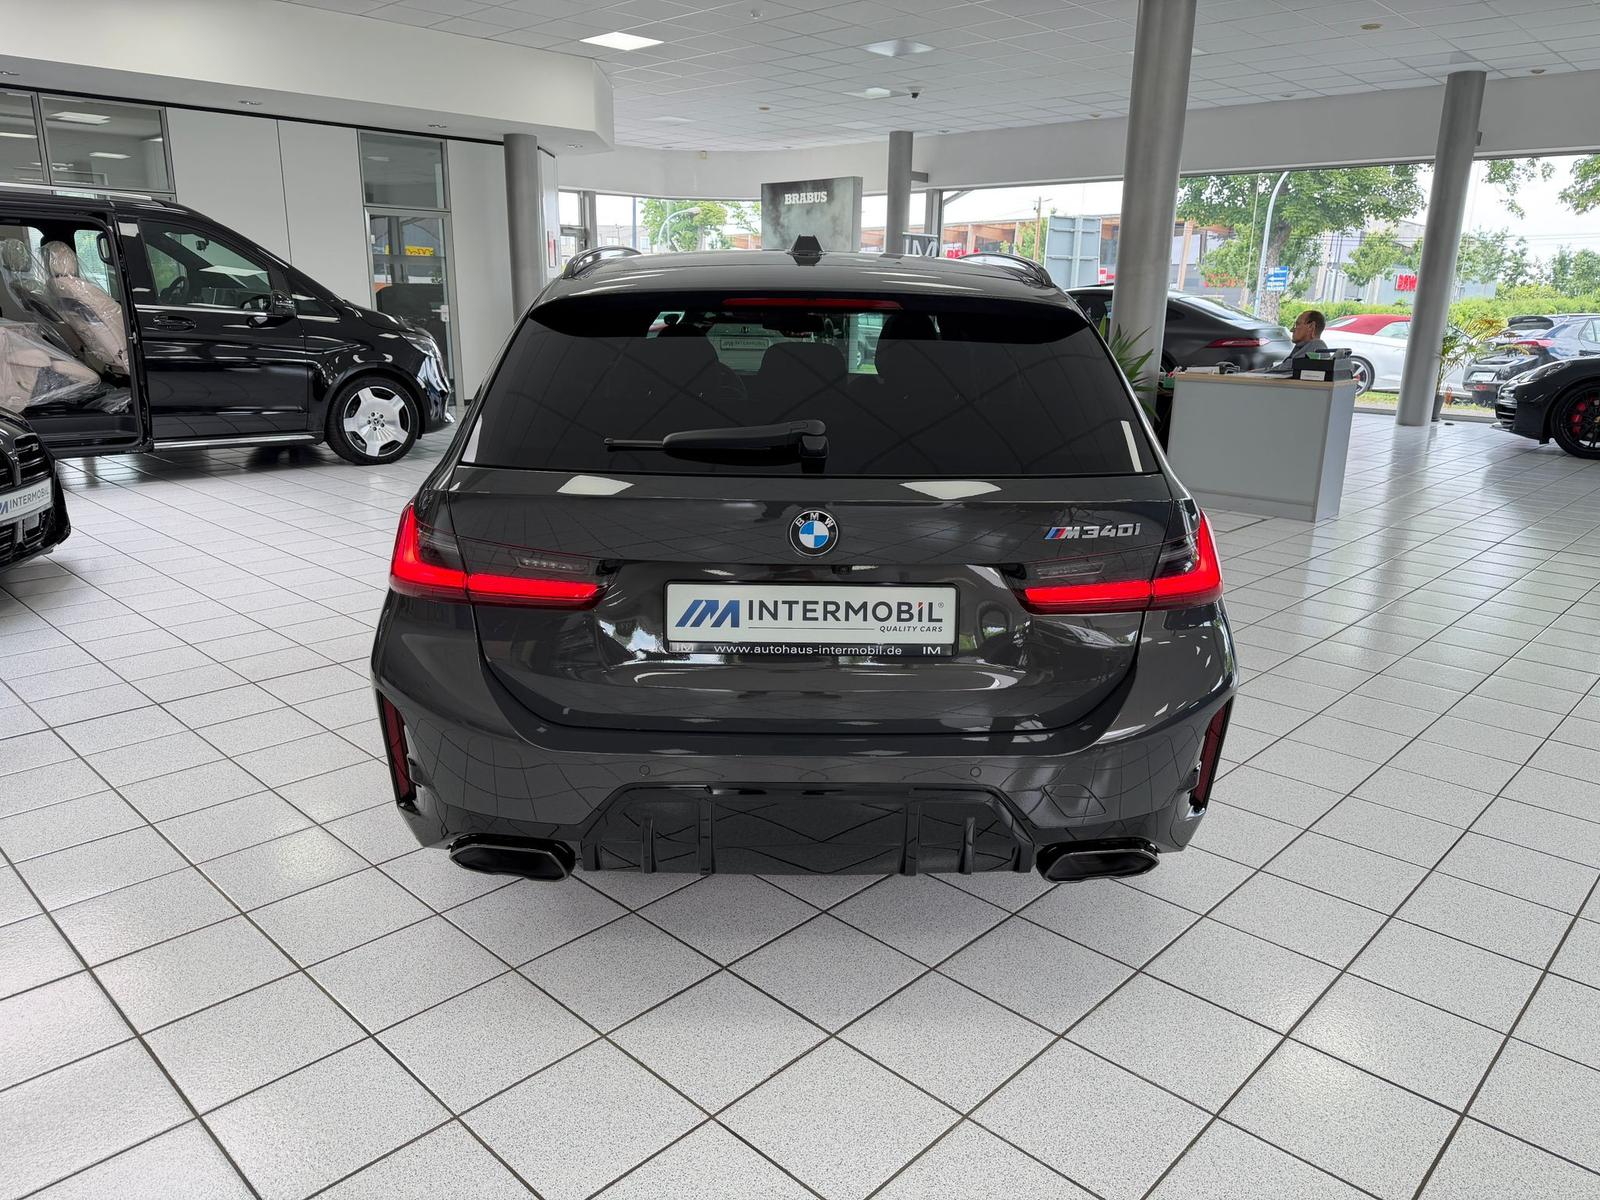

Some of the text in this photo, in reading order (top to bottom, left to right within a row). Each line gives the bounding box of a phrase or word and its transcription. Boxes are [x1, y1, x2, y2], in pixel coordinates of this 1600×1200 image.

[784, 191, 828, 205] BRABUS
[795, 512, 834, 528] BMW
[879, 625, 943, 633] QUALITY CARS
[714, 644, 902, 656] www.autohaus-intermobil.de
[922, 646, 941, 655] IM
